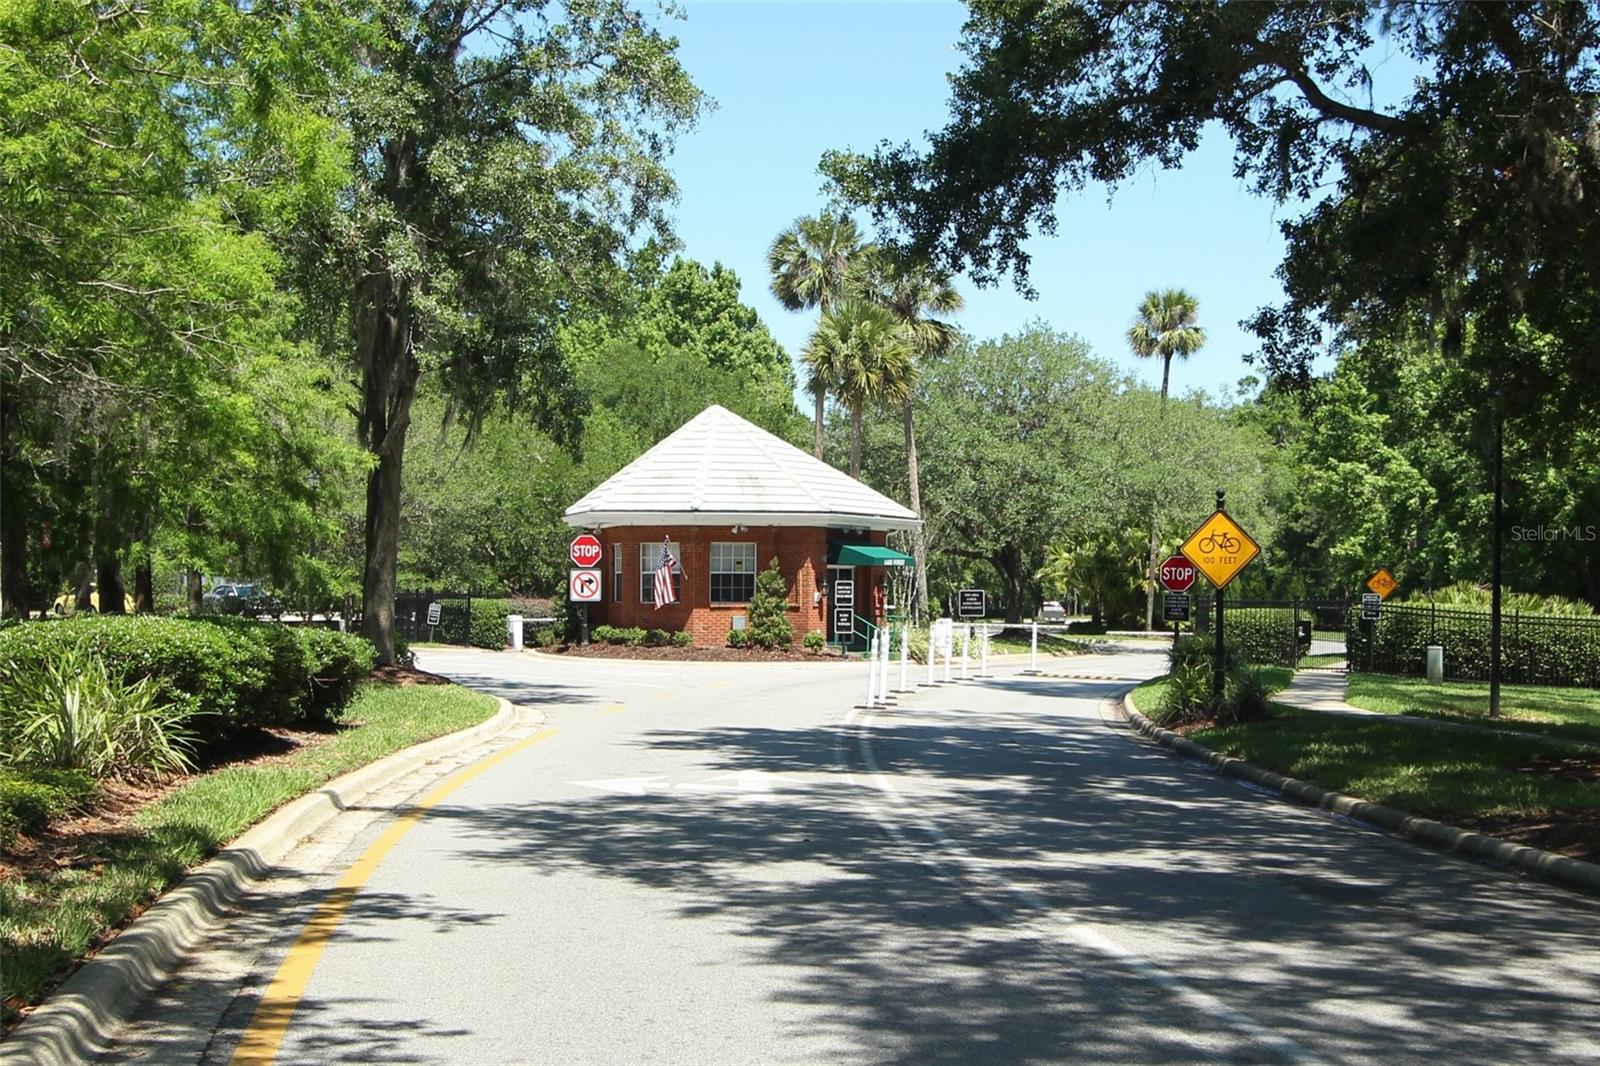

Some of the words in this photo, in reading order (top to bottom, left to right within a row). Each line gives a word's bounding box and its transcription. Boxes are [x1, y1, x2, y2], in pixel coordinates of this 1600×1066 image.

[573, 545, 600, 557] STOP
[1202, 556, 1215, 565] 100
[1219, 556, 1237, 564] FEET
[1162, 567, 1193, 581] STOP
